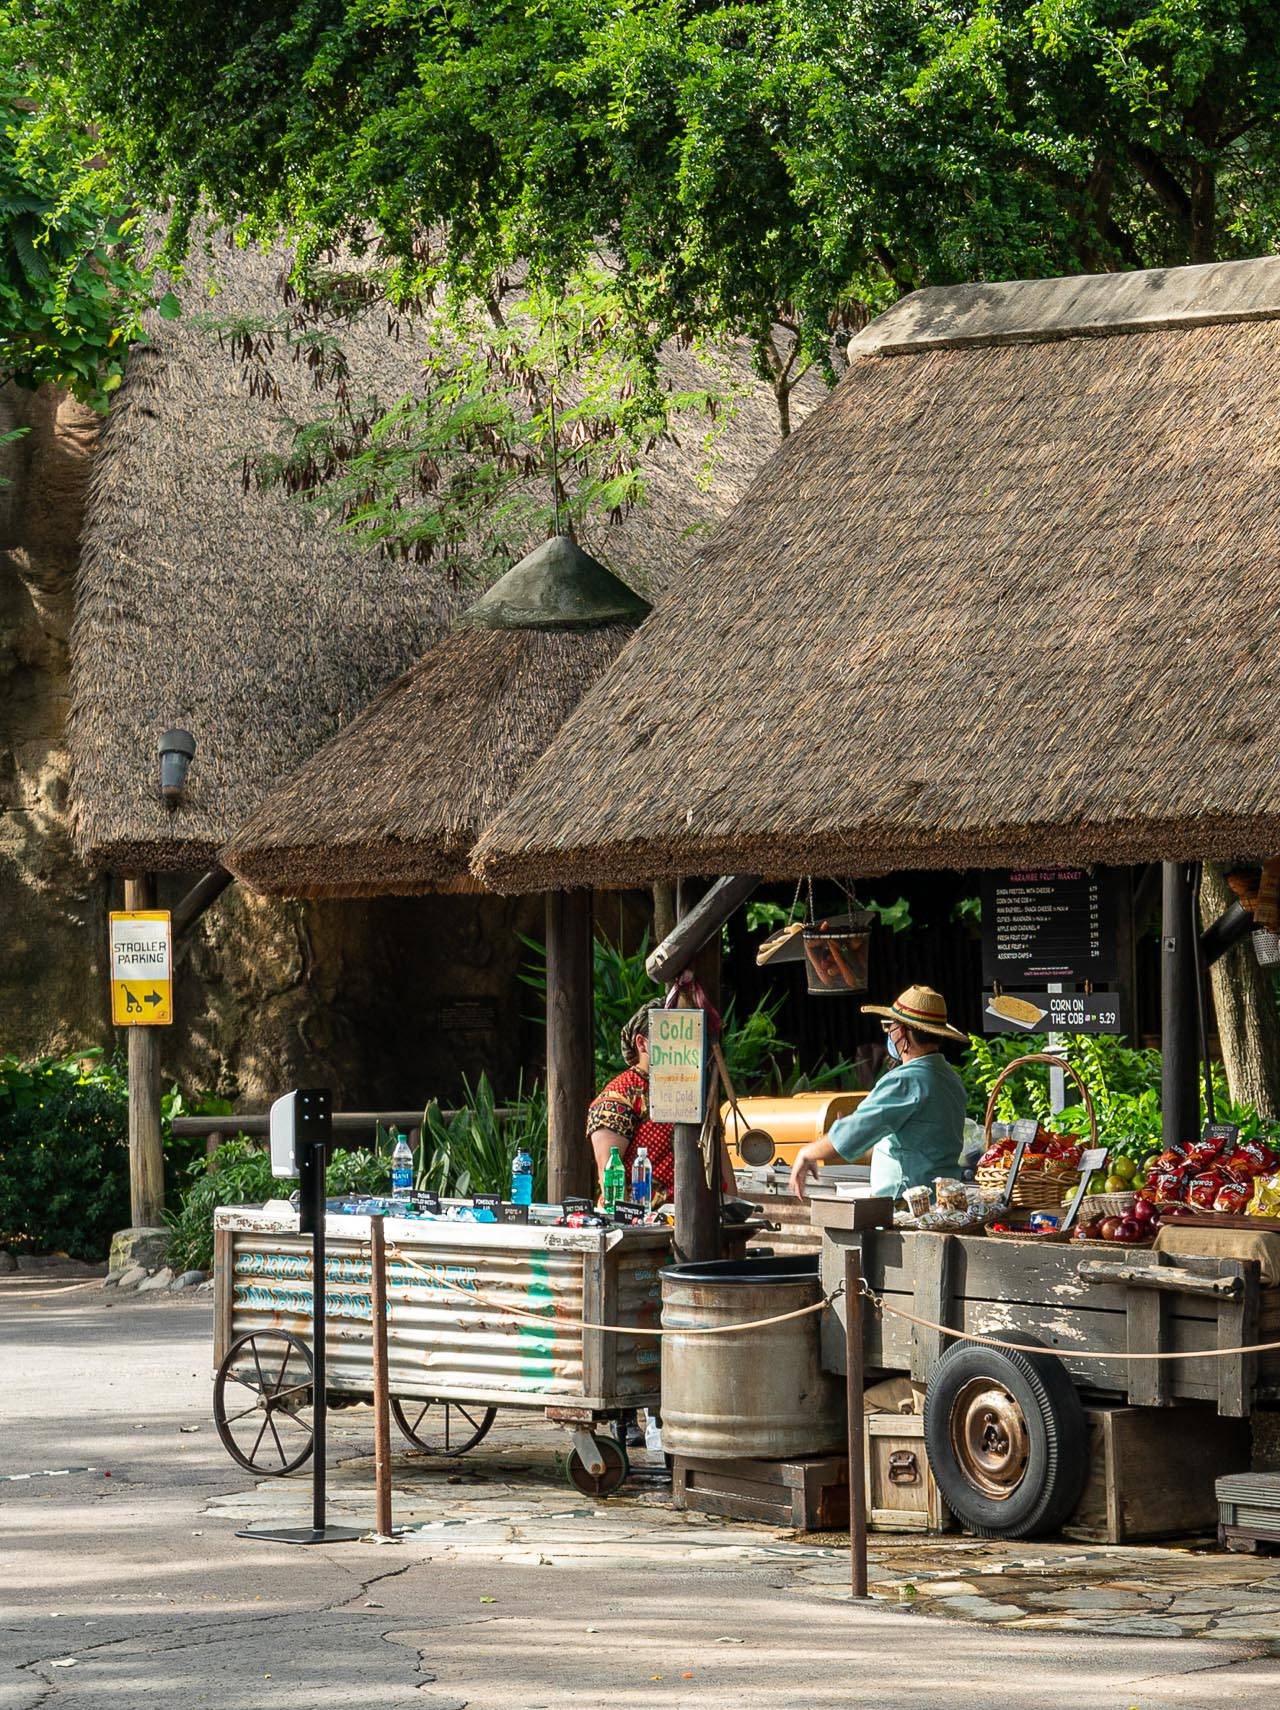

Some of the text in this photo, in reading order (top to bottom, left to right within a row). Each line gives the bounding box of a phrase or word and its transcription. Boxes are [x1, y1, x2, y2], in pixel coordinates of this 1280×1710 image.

[1058, 871, 1082, 880] MARKET
[114, 941, 167, 964] STROLLER PARKING
[1050, 999, 1084, 1011] CORN ON
[1051, 1012, 1116, 1024] THE COB 5.29
[660, 1016, 693, 1040] Cold
[651, 1044, 699, 1066] Drinks
